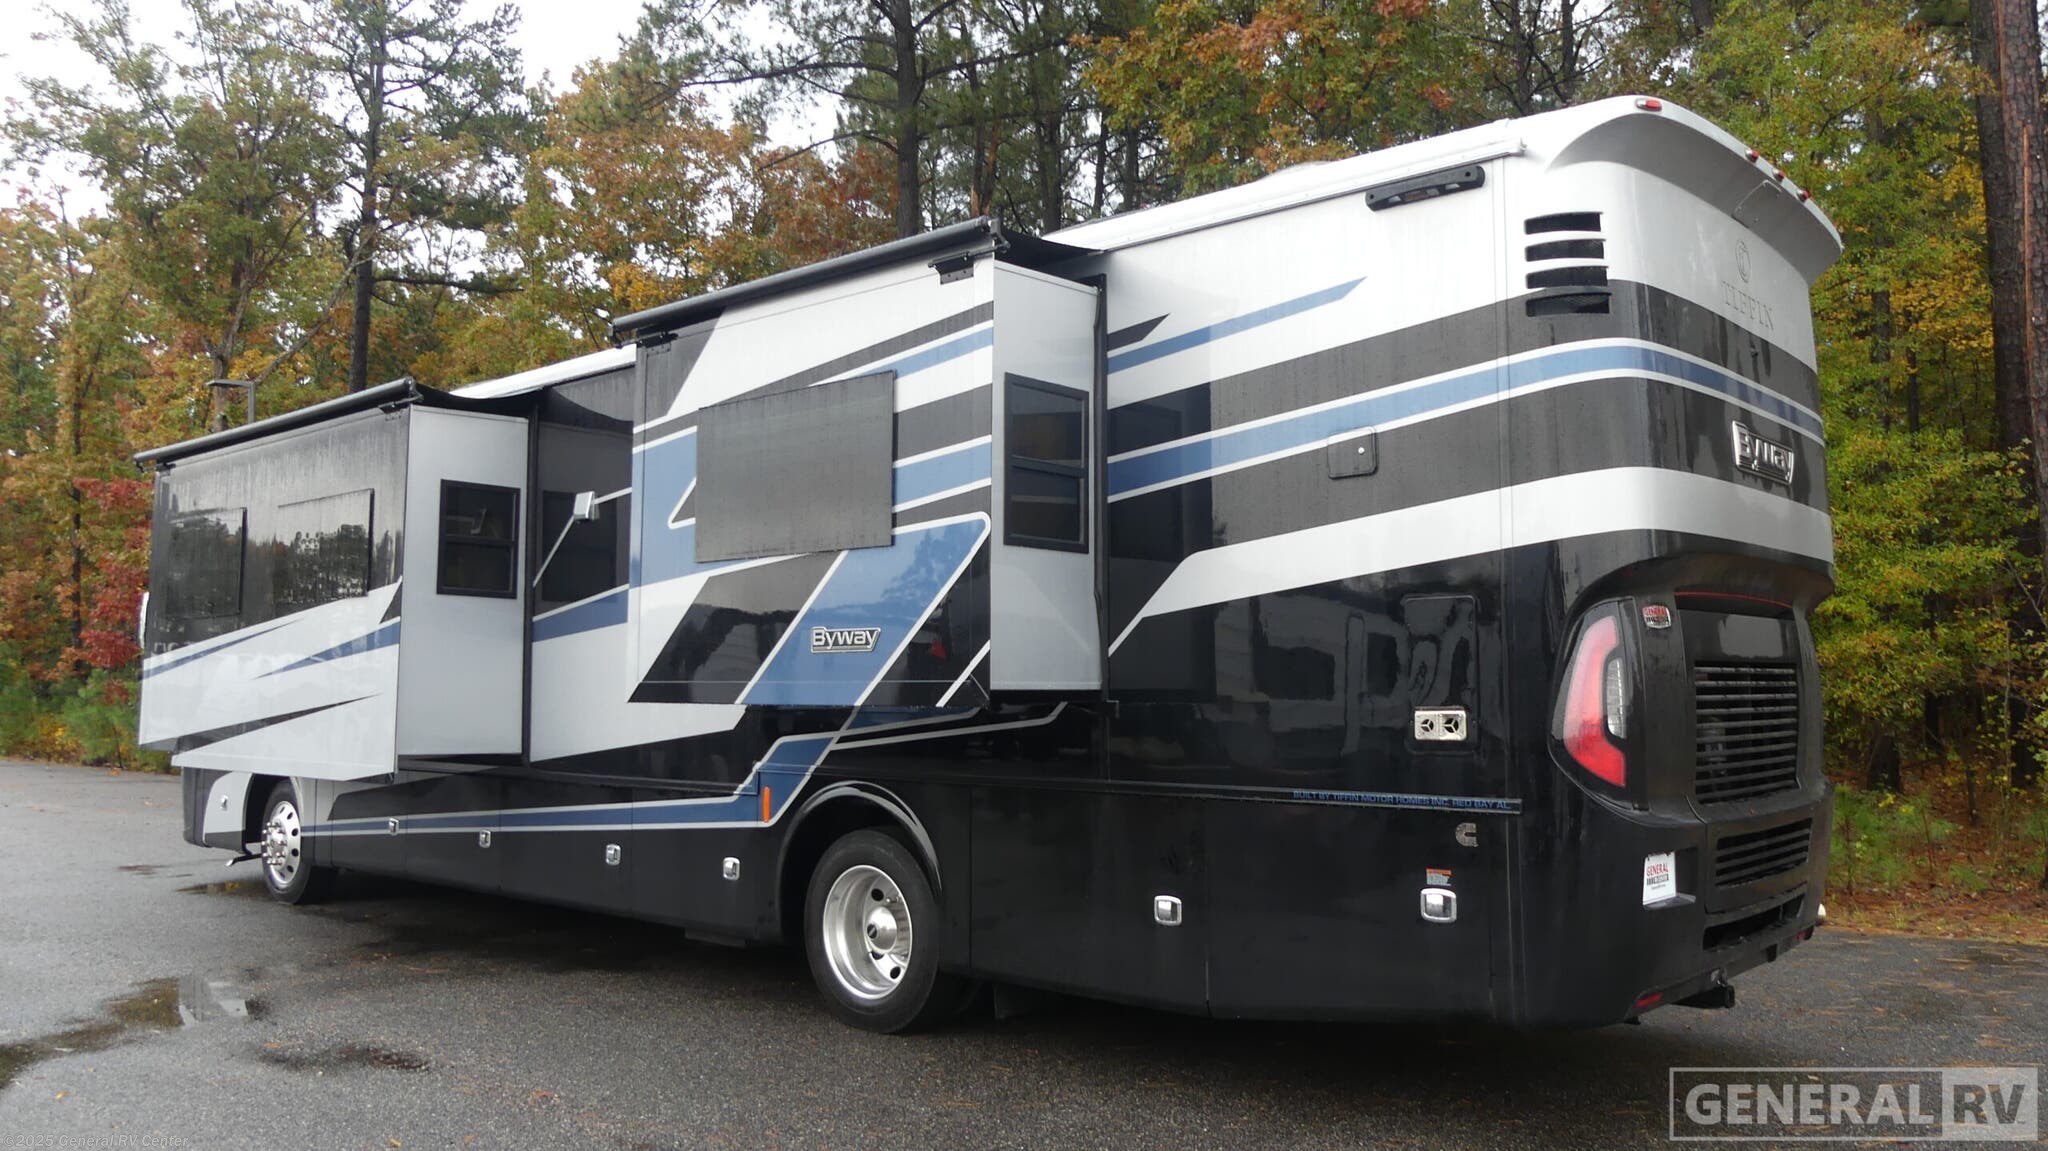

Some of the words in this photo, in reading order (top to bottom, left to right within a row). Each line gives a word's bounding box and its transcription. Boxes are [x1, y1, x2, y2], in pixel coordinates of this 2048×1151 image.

[1734, 424, 1792, 482] Byway
[813, 628, 878, 650] Byway
[1293, 790, 1319, 799] BUILT
[1319, 791, 1330, 800] BY
[1330, 792, 1360, 801] TIFFIN
[1360, 793, 1394, 804] MOTOR
[1397, 795, 1429, 805] HOMES
